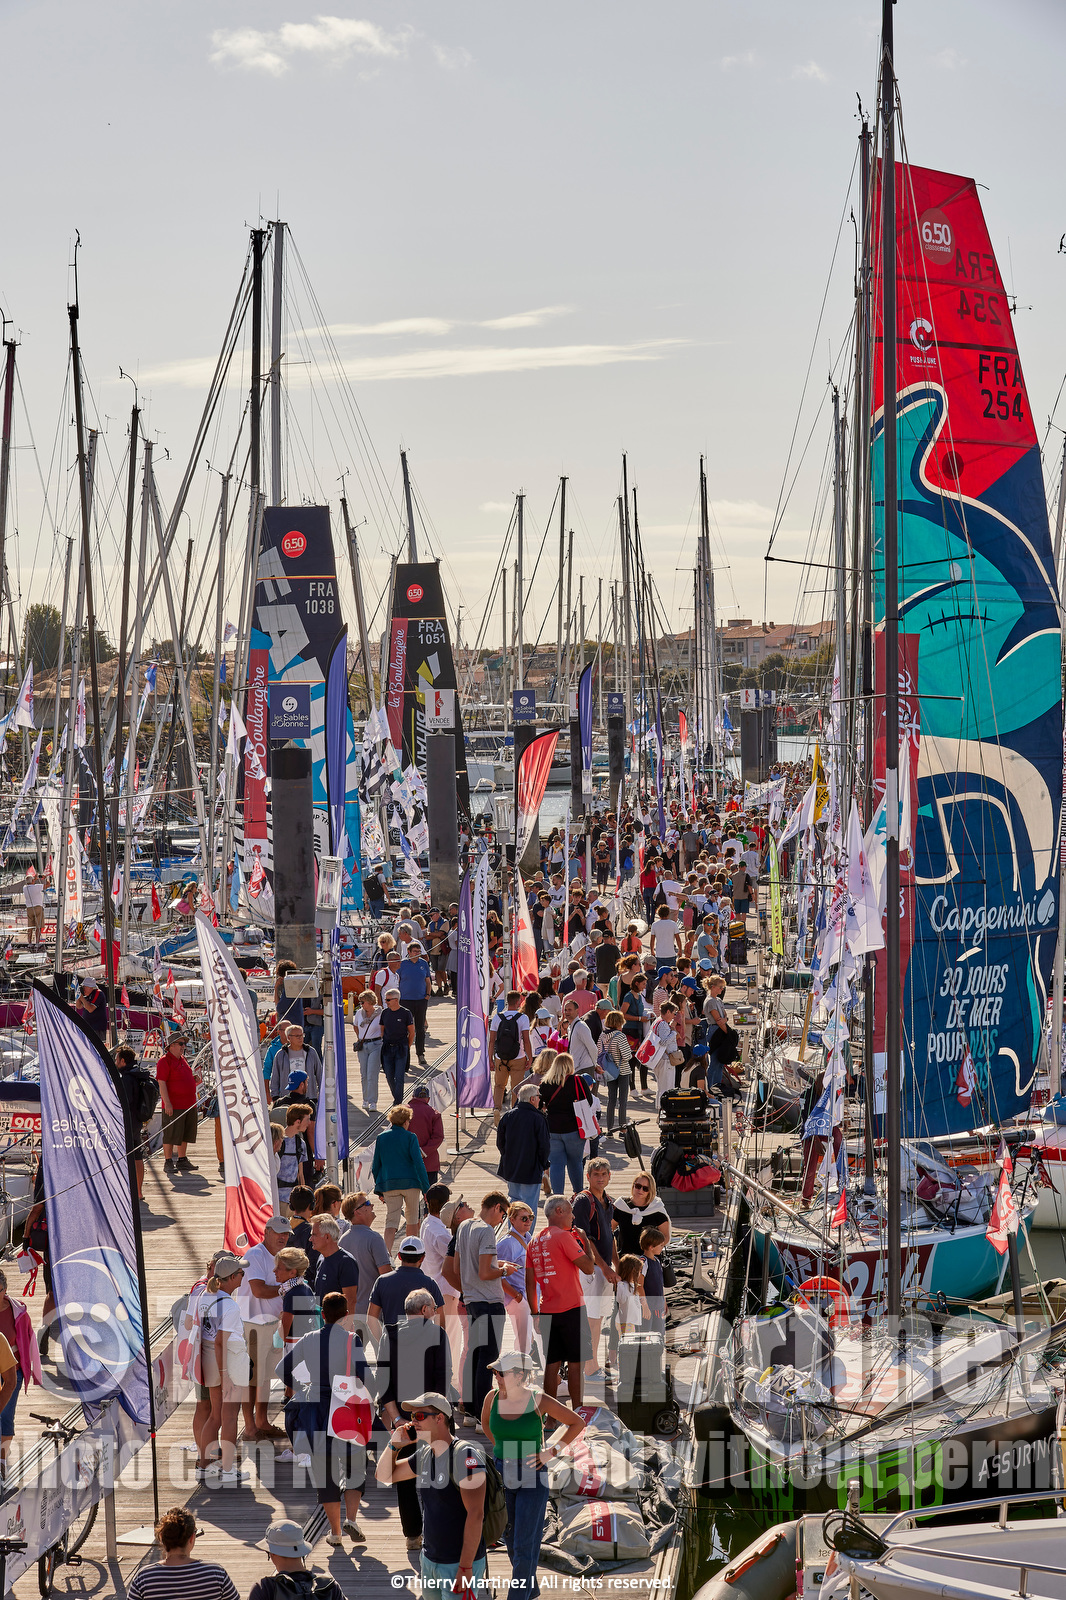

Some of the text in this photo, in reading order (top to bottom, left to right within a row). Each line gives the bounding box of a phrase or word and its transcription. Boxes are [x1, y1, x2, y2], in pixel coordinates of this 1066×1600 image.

[921, 221, 951, 246] 6.50
[978, 354, 1023, 388] FRA
[981, 389, 1024, 422] 254
[284, 538, 304, 550] 6.50
[309, 582, 334, 597] FRA
[407, 588, 422, 597] 6.50
[305, 600, 334, 614] 1038
[418, 622, 444, 633] FRA
[418, 633, 446, 645] 1051
[388, 629, 407, 708] la Boulangère
[284, 713, 309, 721] Sables
[930, 893, 1036, 946] Capgemini
[940, 964, 1009, 997] 30 JOURS
[946, 996, 1003, 1029] DE MER
[969, 1029, 998, 1060] NOS
[948, 1061, 991, 1094] HOS
[14, 1116, 42, 1132] 903
